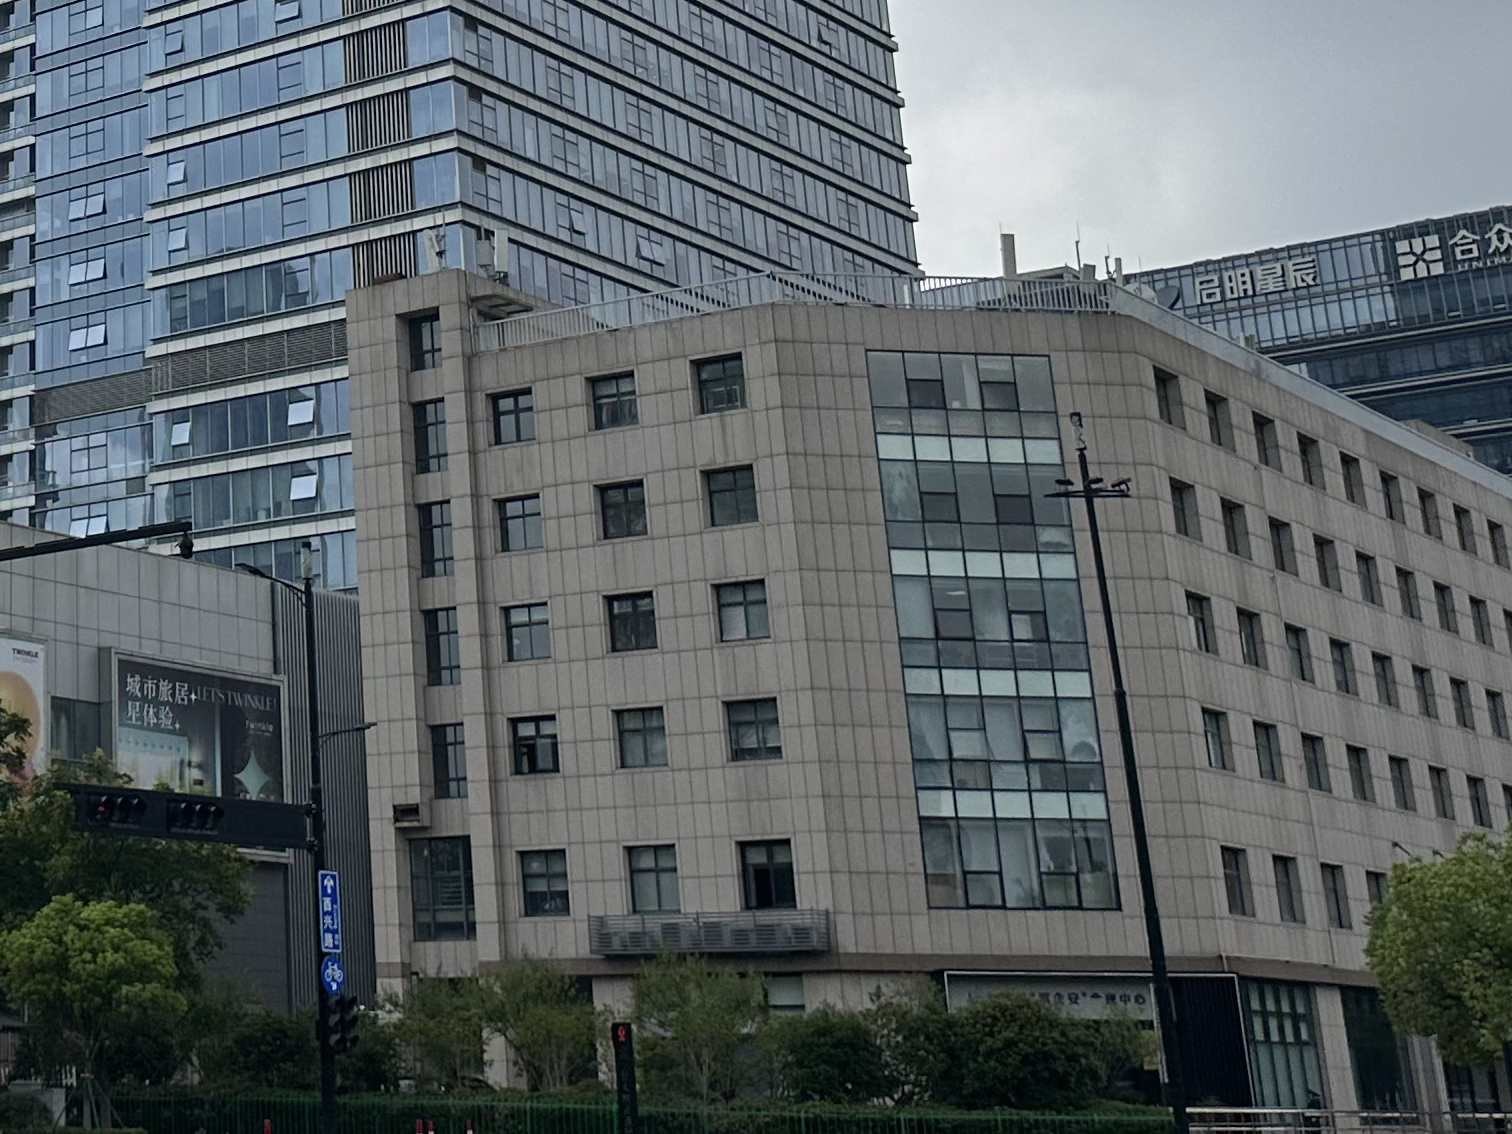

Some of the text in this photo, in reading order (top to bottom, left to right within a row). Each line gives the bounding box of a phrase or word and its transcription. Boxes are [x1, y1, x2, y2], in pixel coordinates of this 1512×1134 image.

[1449, 223, 1512, 260] 合众
[1457, 256, 1512, 271] UNIM
[1195, 256, 1319, 305] 启明星辰
[126, 673, 189, 705] 城市旅居
[126, 700, 174, 729] 星体验
